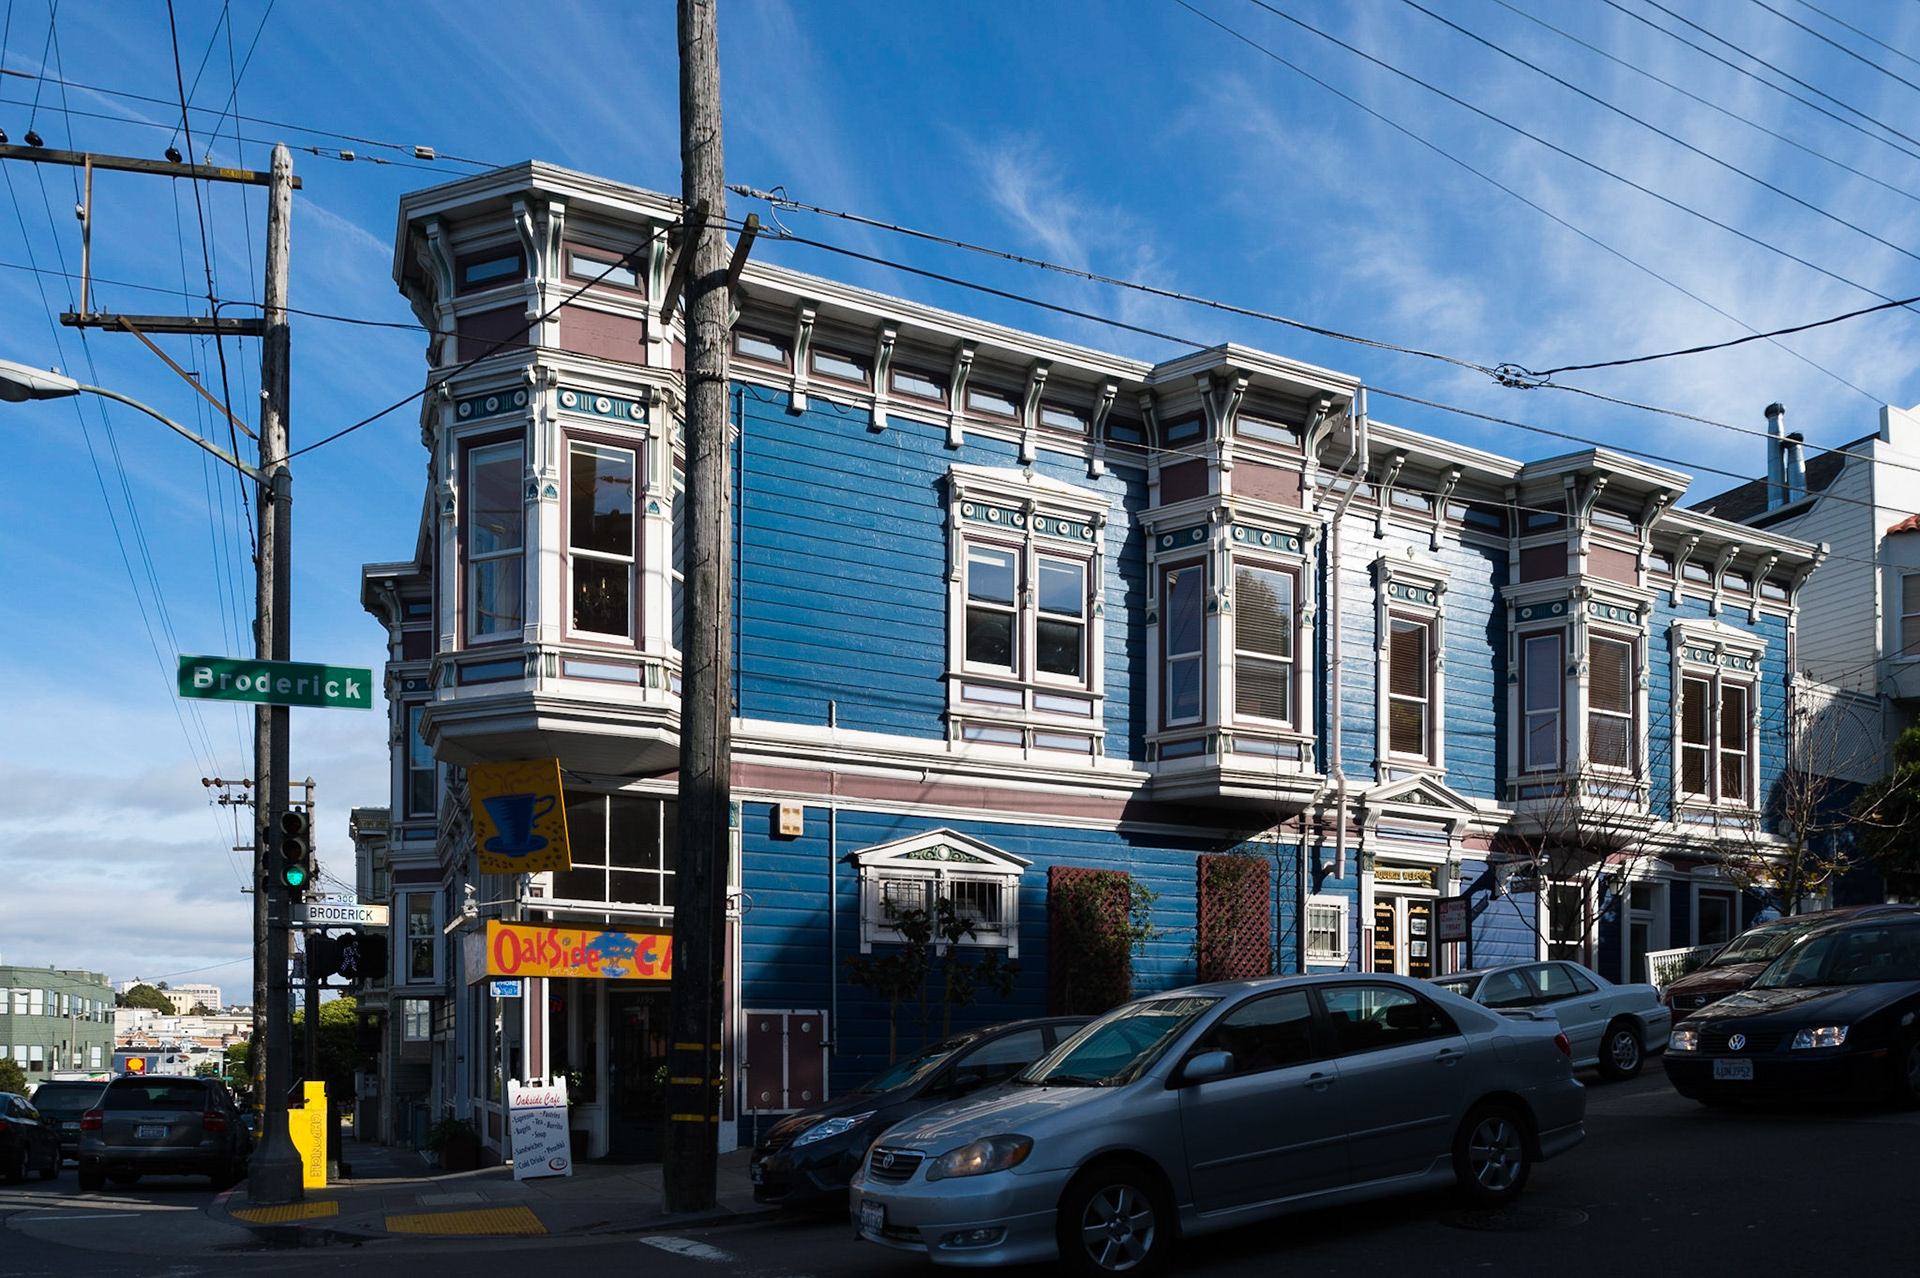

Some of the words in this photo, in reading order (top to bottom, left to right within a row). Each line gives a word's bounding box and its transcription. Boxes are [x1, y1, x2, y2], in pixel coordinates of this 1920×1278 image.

[193, 666, 362, 699] Broderick
[310, 907, 373, 921] BRODERICK
[516, 1094, 543, 1106] Oakside
[544, 1092, 561, 1106] Cafe
[310, 1113, 323, 1178] CHRONICLE
